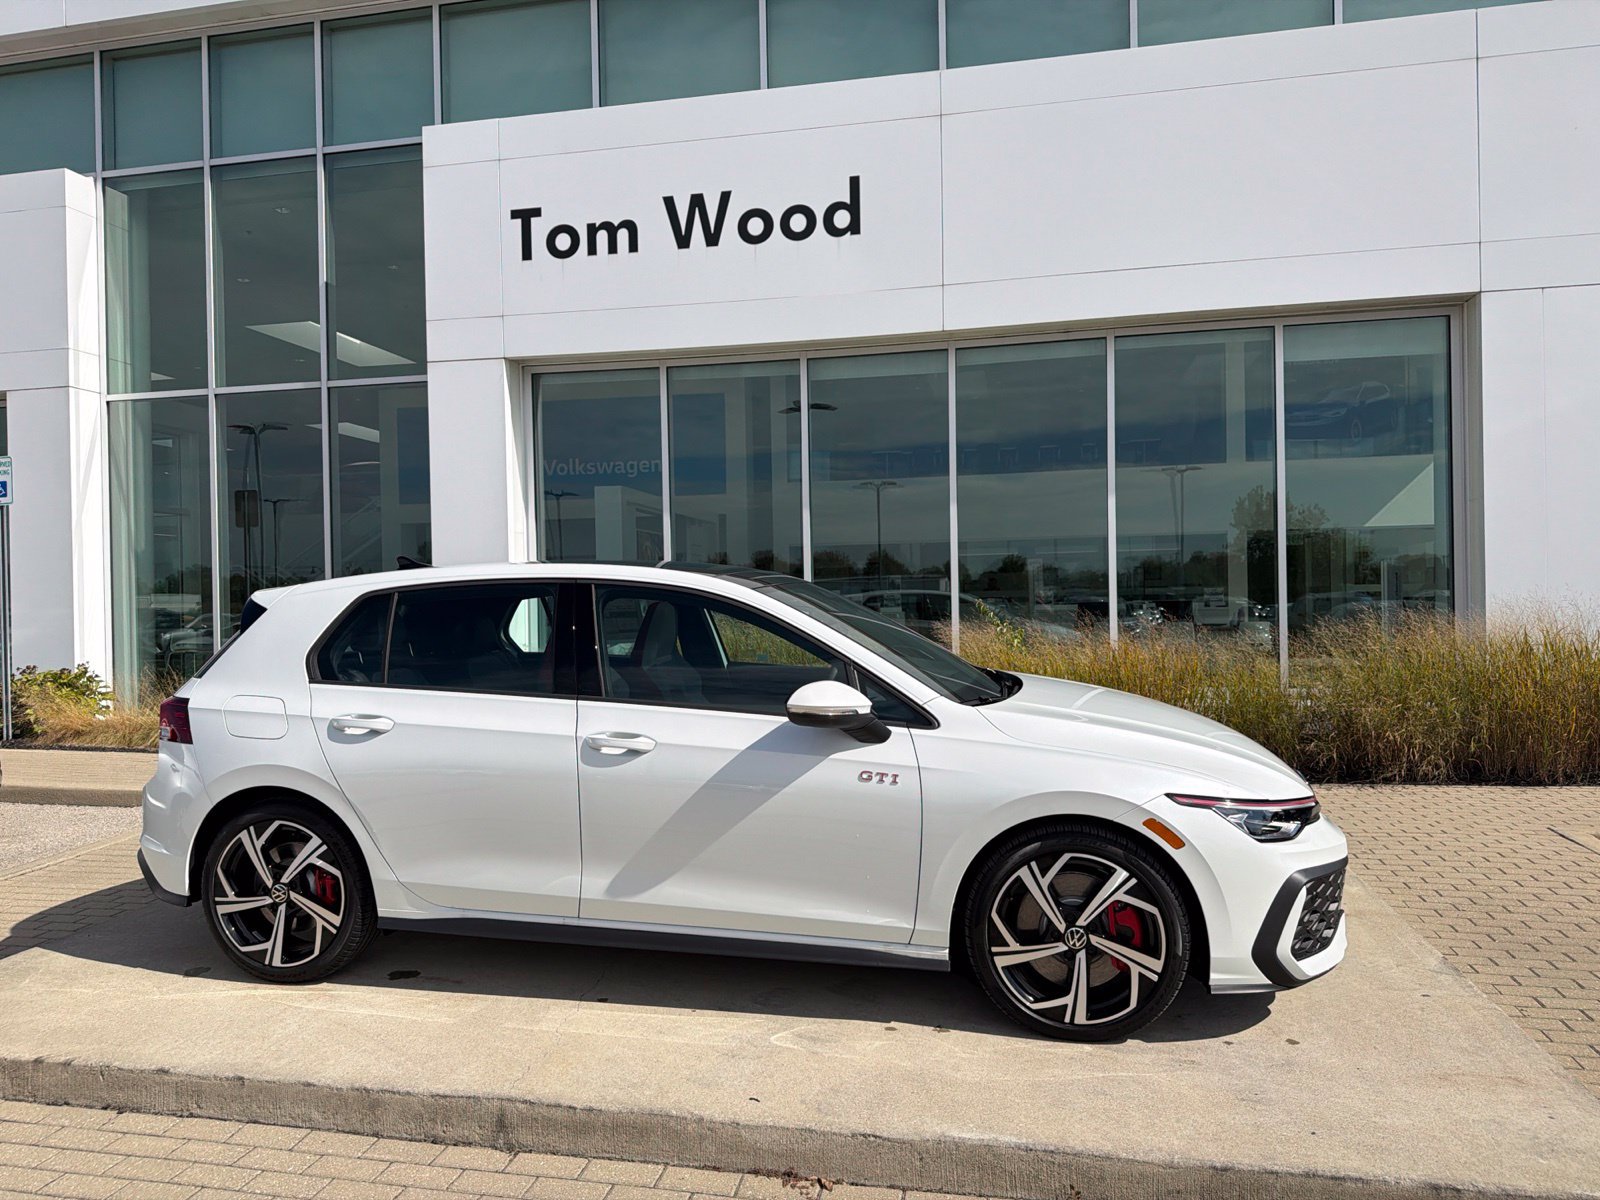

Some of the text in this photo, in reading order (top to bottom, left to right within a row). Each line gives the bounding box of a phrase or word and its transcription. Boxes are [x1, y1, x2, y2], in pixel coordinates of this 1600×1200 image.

[510, 175, 861, 261] Tom Wood
[543, 458, 662, 478] Volkswagen
[858, 770, 899, 785] GTI
